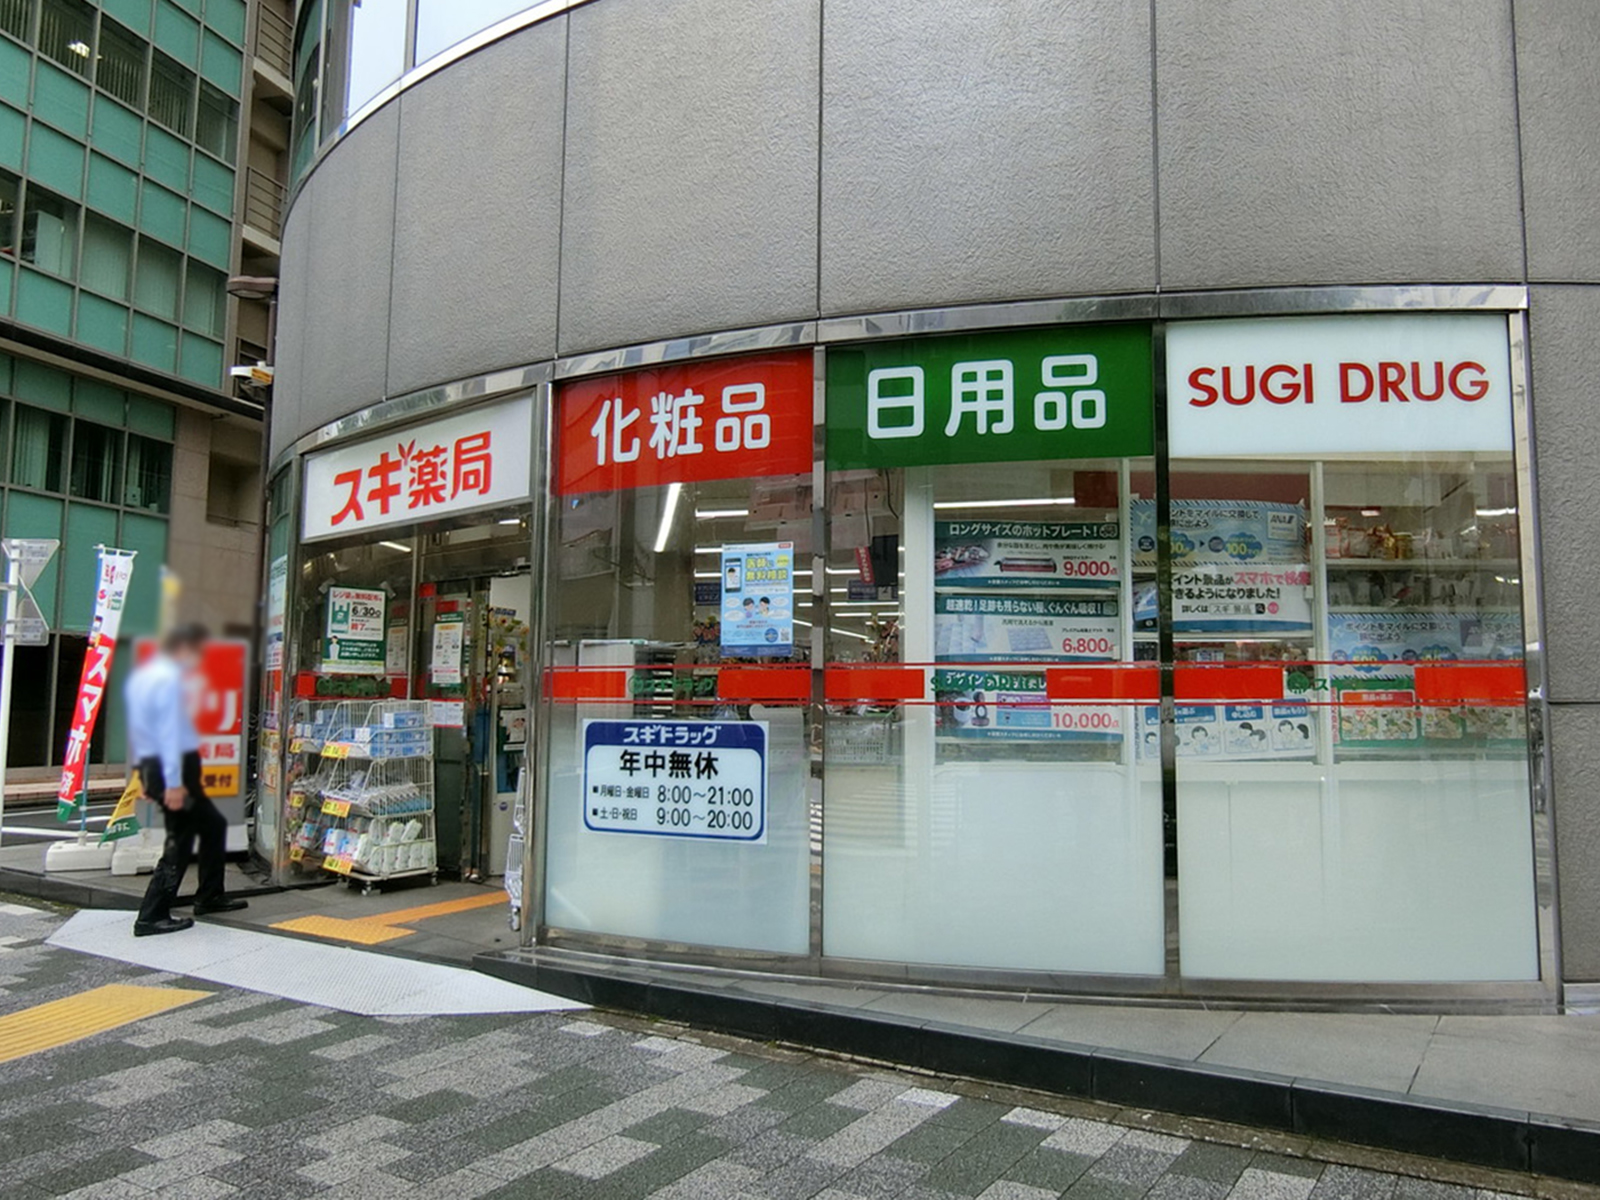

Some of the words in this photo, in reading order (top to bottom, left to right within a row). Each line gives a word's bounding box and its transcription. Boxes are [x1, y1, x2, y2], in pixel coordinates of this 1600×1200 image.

[866, 353, 1108, 440] 日用品
[1188, 363, 1315, 408] SUGI
[1340, 360, 1490, 404] DRUG
[590, 381, 772, 467] 化粧品
[330, 430, 493, 526] スギ薬局
[949, 523, 1098, 538] ロングサイズのホットプレート！
[623, 723, 722, 744] スギドラッグ
[619, 748, 720, 781] 年中無休
[656, 784, 754, 808] 8:00～21:00
[656, 806, 754, 832] 9:00～20:00
